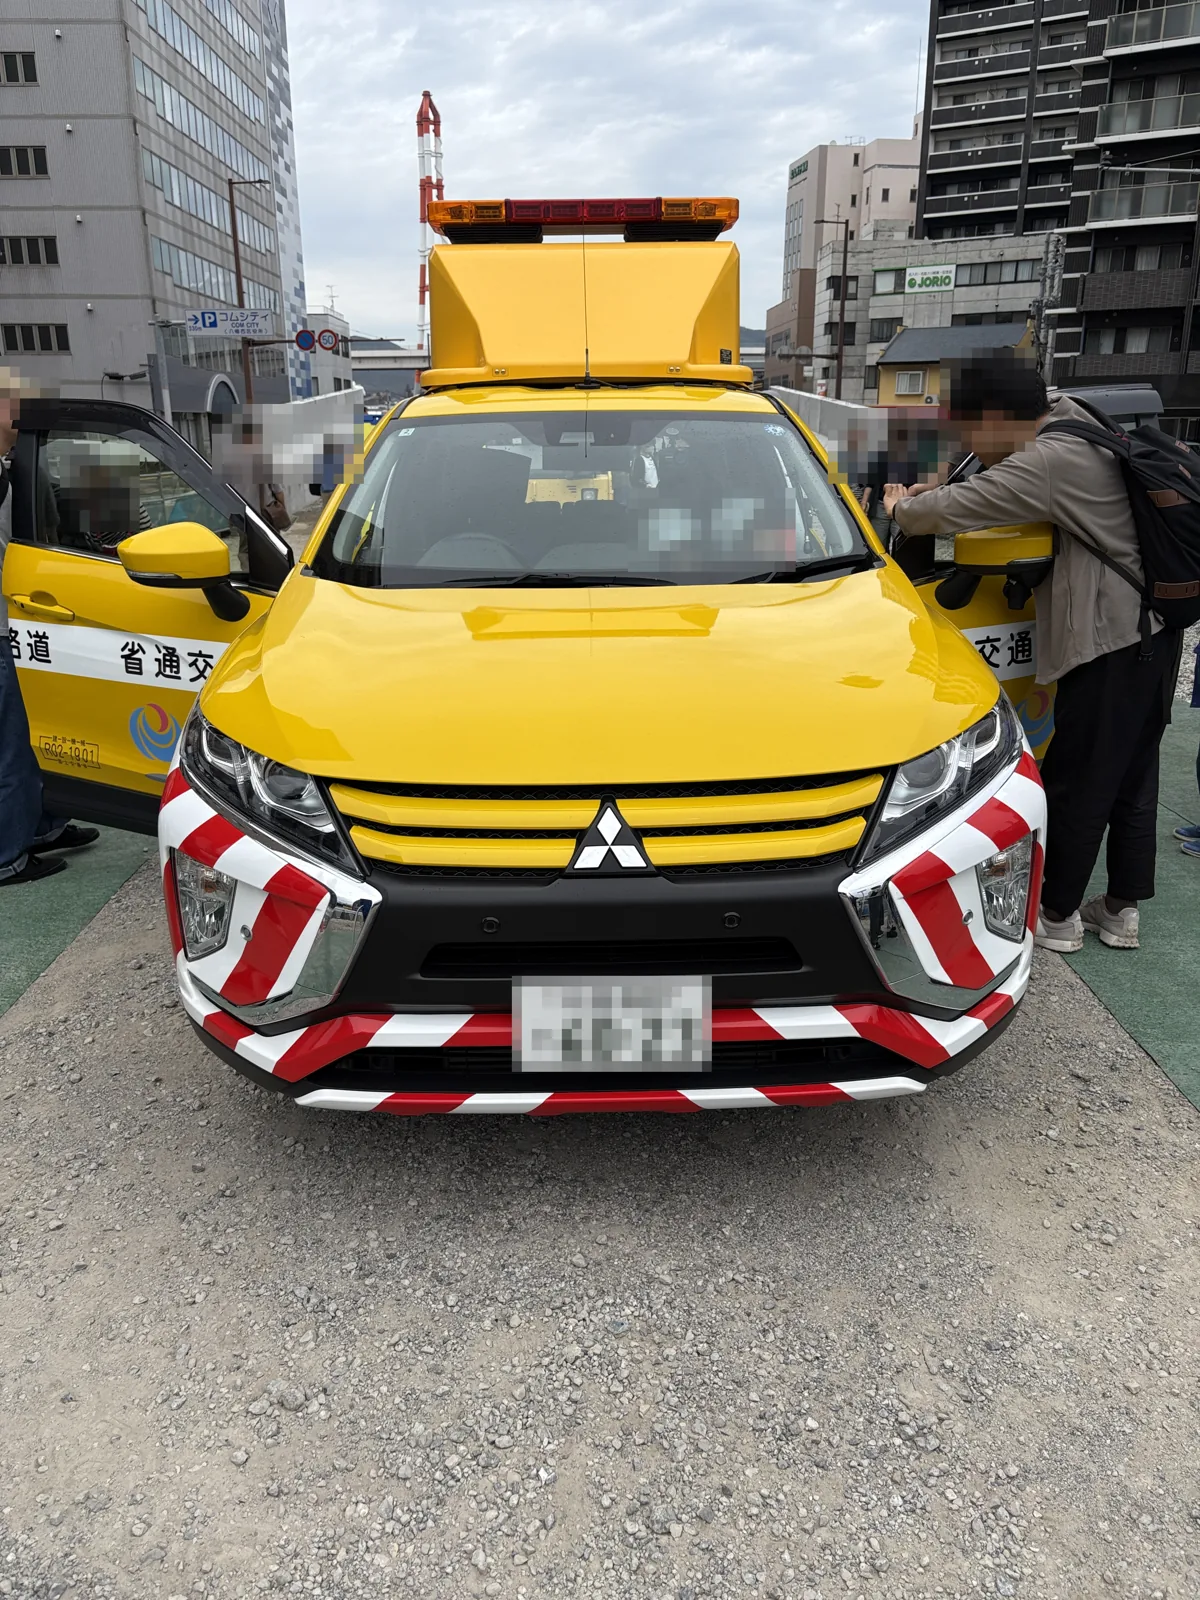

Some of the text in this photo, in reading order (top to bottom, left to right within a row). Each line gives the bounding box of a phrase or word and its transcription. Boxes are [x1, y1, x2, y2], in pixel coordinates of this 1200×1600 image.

[918, 275, 952, 288] JORIO
[219, 312, 269, 322] コムシティ
[321, 335, 334, 346] 50
[974, 630, 1033, 669] 交通
[121, 641, 214, 683] 省通交
[44, 742, 95, 765] R02-1901
